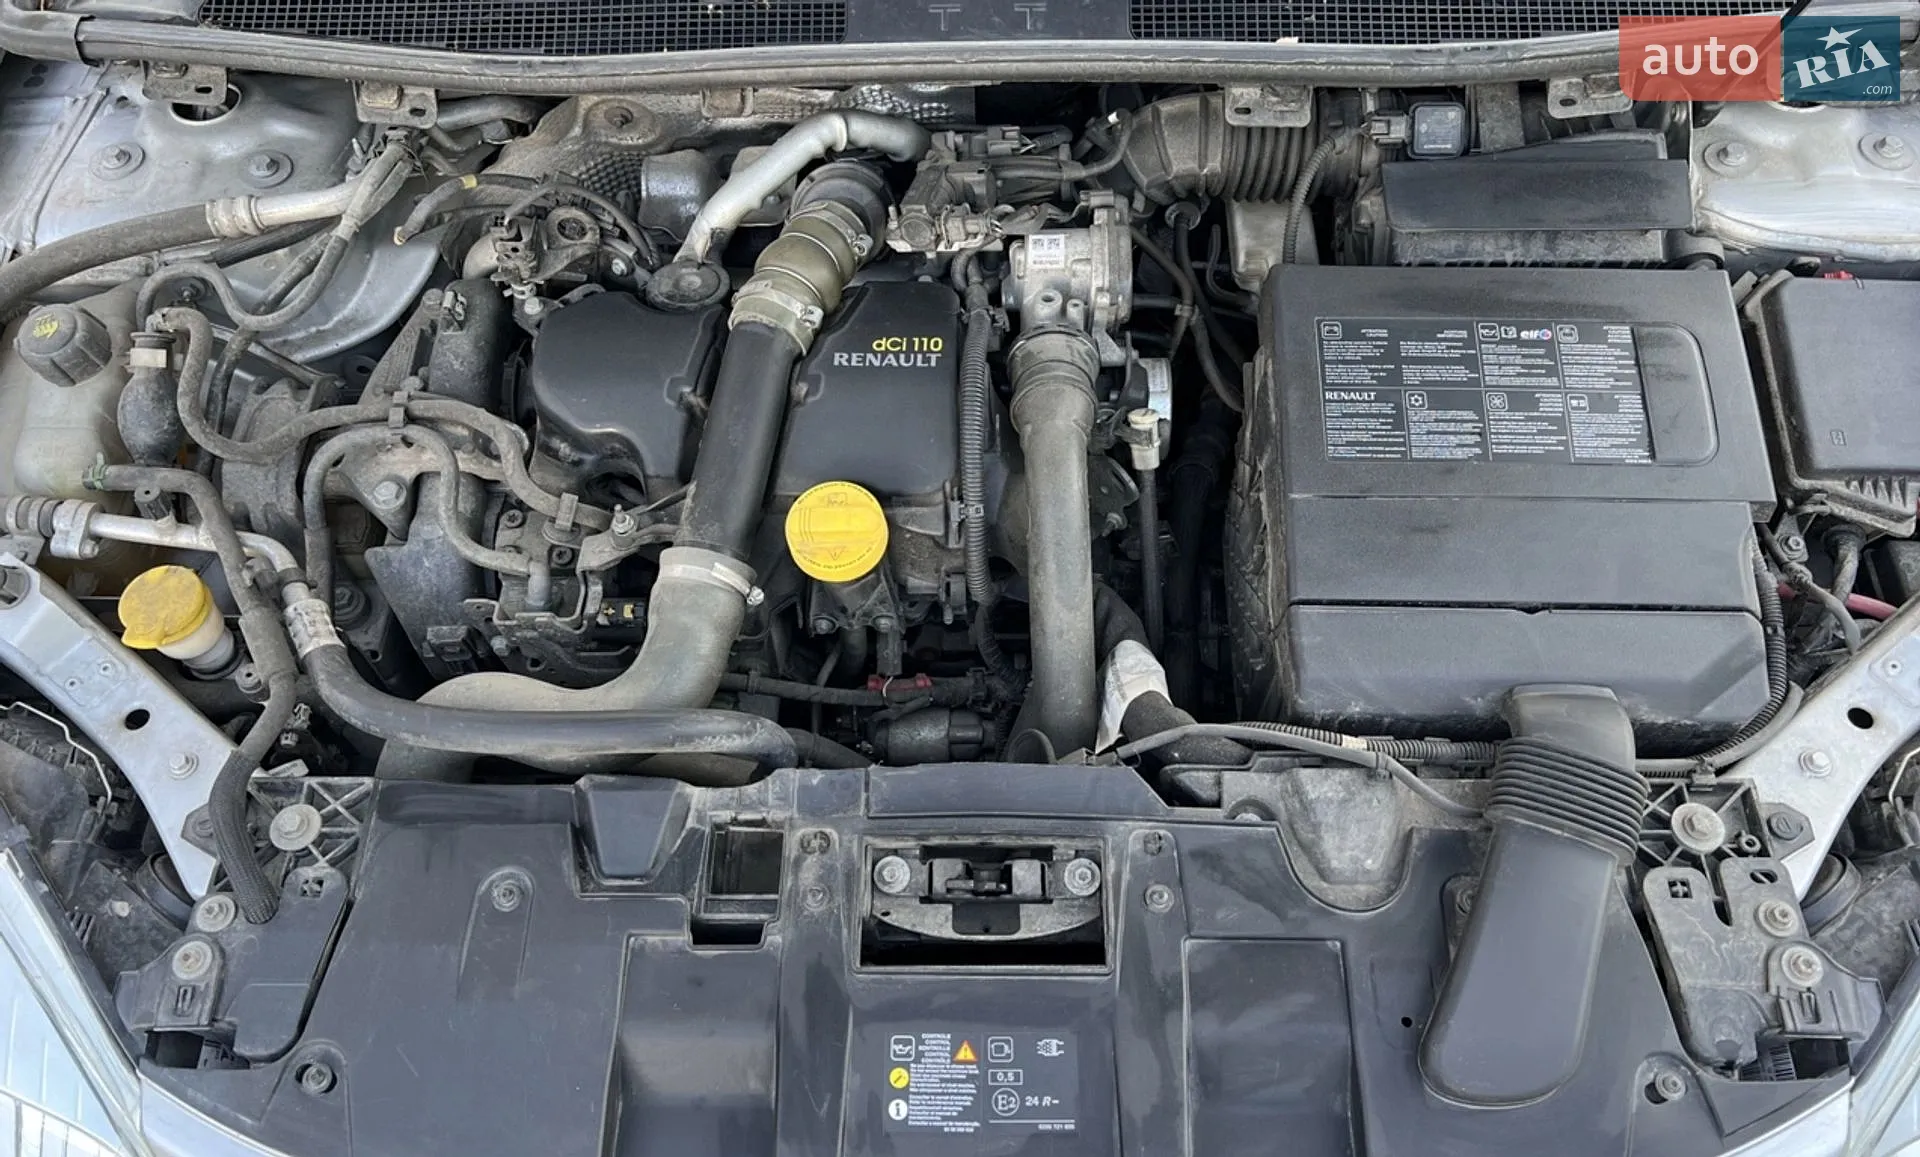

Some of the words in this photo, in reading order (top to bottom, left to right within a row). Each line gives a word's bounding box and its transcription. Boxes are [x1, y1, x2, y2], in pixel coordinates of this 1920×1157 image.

[1520, 329, 1541, 340] elf
[872, 336, 907, 352] dCi
[912, 336, 943, 352] 110
[833, 352, 942, 368] RENAULT
[1324, 391, 1377, 401] RENAULT
[996, 1072, 1015, 1083] 0,5
[997, 1094, 1017, 1111] E2
[1025, 1096, 1039, 1107] 24
